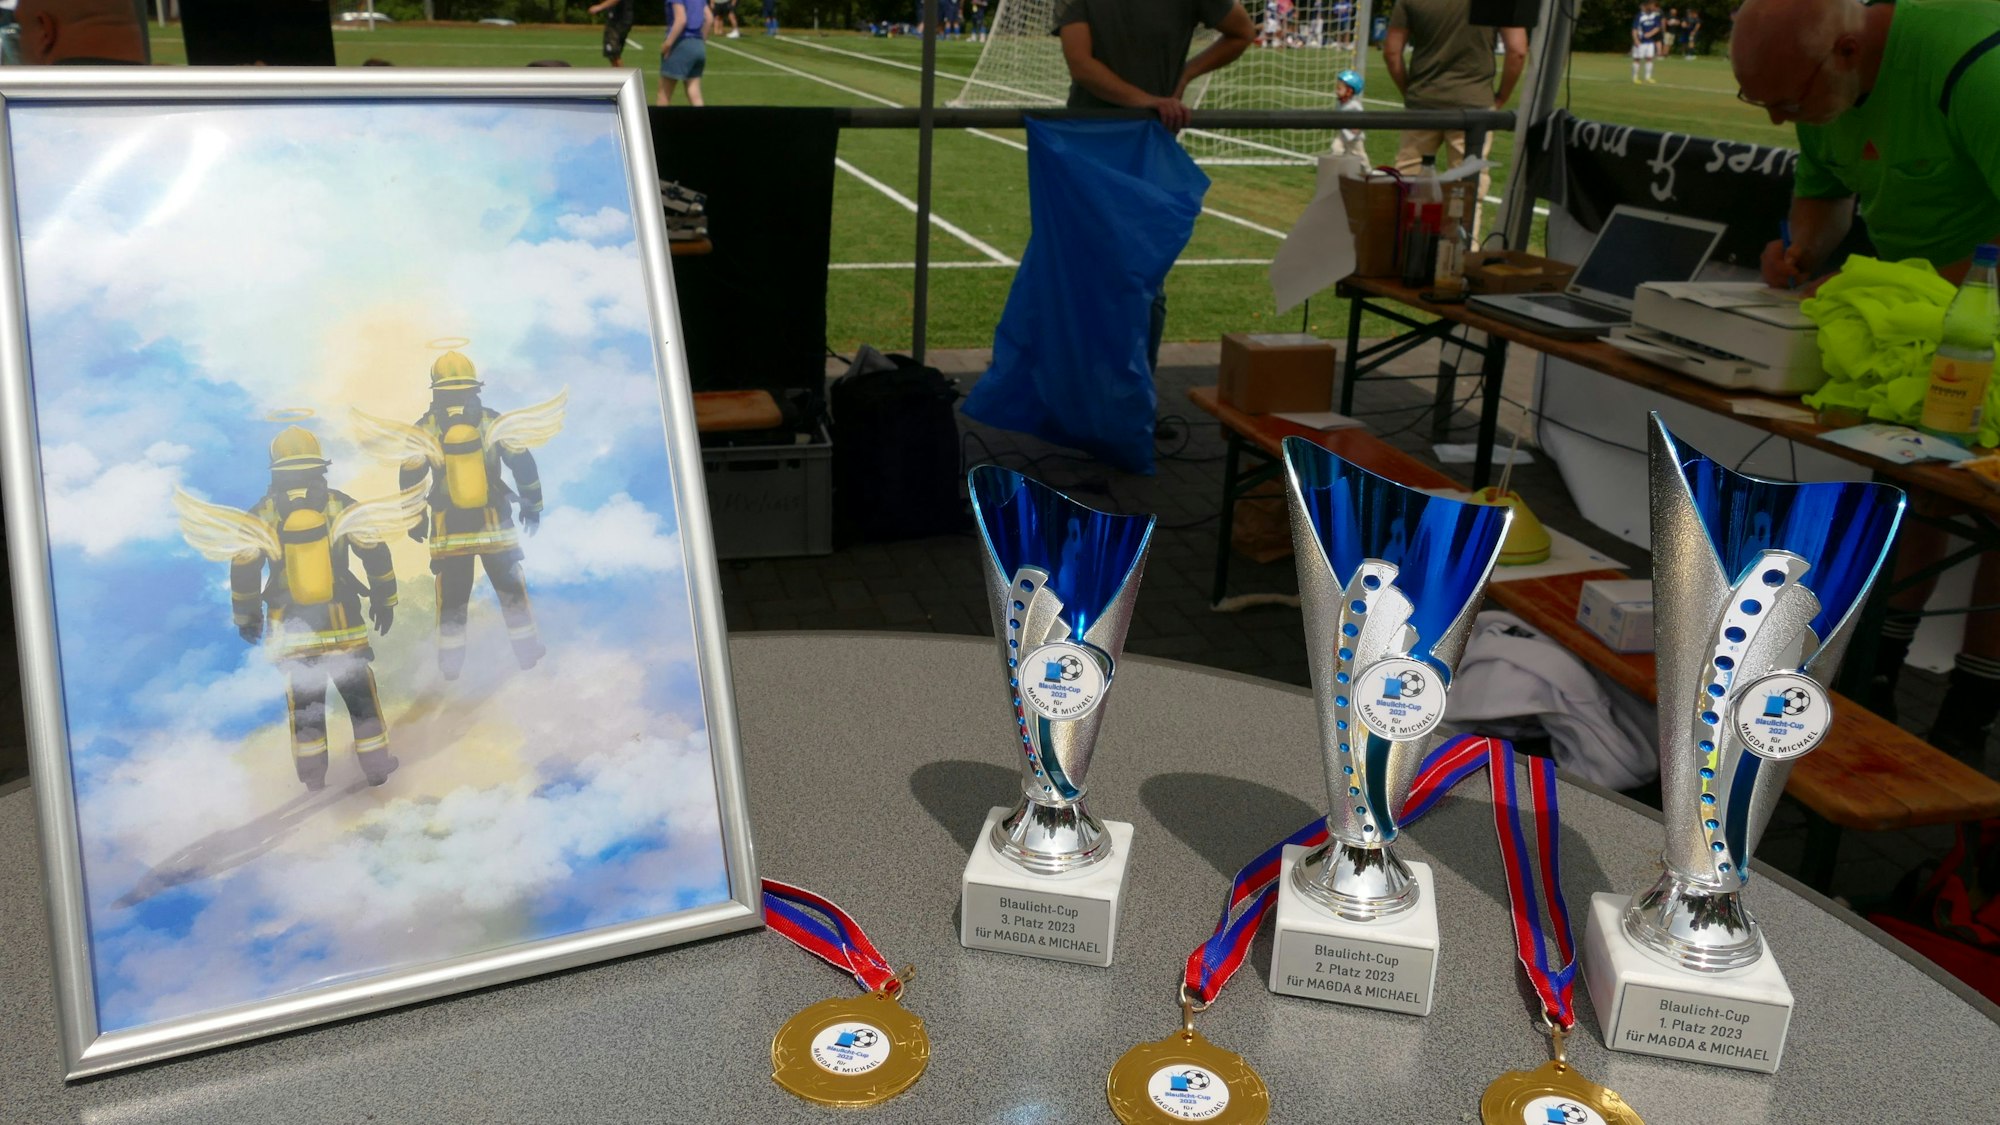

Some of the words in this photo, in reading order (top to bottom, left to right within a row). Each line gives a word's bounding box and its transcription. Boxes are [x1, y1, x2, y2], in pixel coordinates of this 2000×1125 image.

[1646, 132, 1690, 201] &
[1039, 682, 1081, 693] Blaulicht-Cup
[1027, 687, 1049, 711] MAGDA
[1061, 695, 1093, 714] MICHAEL
[1376, 700, 1421, 711] Blaulicht-Cup
[1364, 704, 1387, 730] MAGDA
[1400, 713, 1435, 733] MICHAEL
[1755, 718, 1804, 730] Blaulicht-Cup
[1741, 723, 1764, 750] MAGDA
[1778, 731, 1818, 753] MICHAEL
[1768, 727, 1787, 735] 2023
[1000, 897, 1078, 918] Blaulicht-Cup
[1001, 914, 1010, 925] 3.
[1014, 916, 1043, 929] Platz
[1048, 920, 1075, 933] 2023
[976, 927, 992, 938] für
[994, 929, 1035, 944] MAGDA
[1038, 934, 1046, 945] &
[1049, 936, 1101, 953] MICHAEL
[1315, 944, 1399, 966] Blaulicht-Cup
[1316, 962, 1325, 973] 2.
[1329, 964, 1360, 978] Platz
[1365, 969, 1394, 982] 2023
[1287, 975, 1304, 987] für
[1307, 978, 1351, 993] MAGDA
[1354, 985, 1362, 995] &
[1365, 987, 1421, 1003] MICHAEL
[1660, 999, 1750, 1025] Blaulicht-Cup
[1660, 1018, 1667, 1028] 1.
[1672, 1019, 1705, 1034] Platz
[1711, 1025, 1742, 1039] 2023
[827, 1046, 869, 1058] Blaulicht-Cup
[1626, 1030, 1645, 1042] für
[1647, 1032, 1695, 1050] MAGDA
[1698, 1041, 1707, 1051] &
[1710, 1043, 1769, 1061] MICHAEL
[814, 1048, 831, 1068] MAGDA
[842, 1060, 880, 1073] MICHAEL
[1153, 1095, 1179, 1115] MAGDA
[1193, 1101, 1226, 1118] MICHAEL
[1165, 1092, 1211, 1101] Blaulicht-Cup
